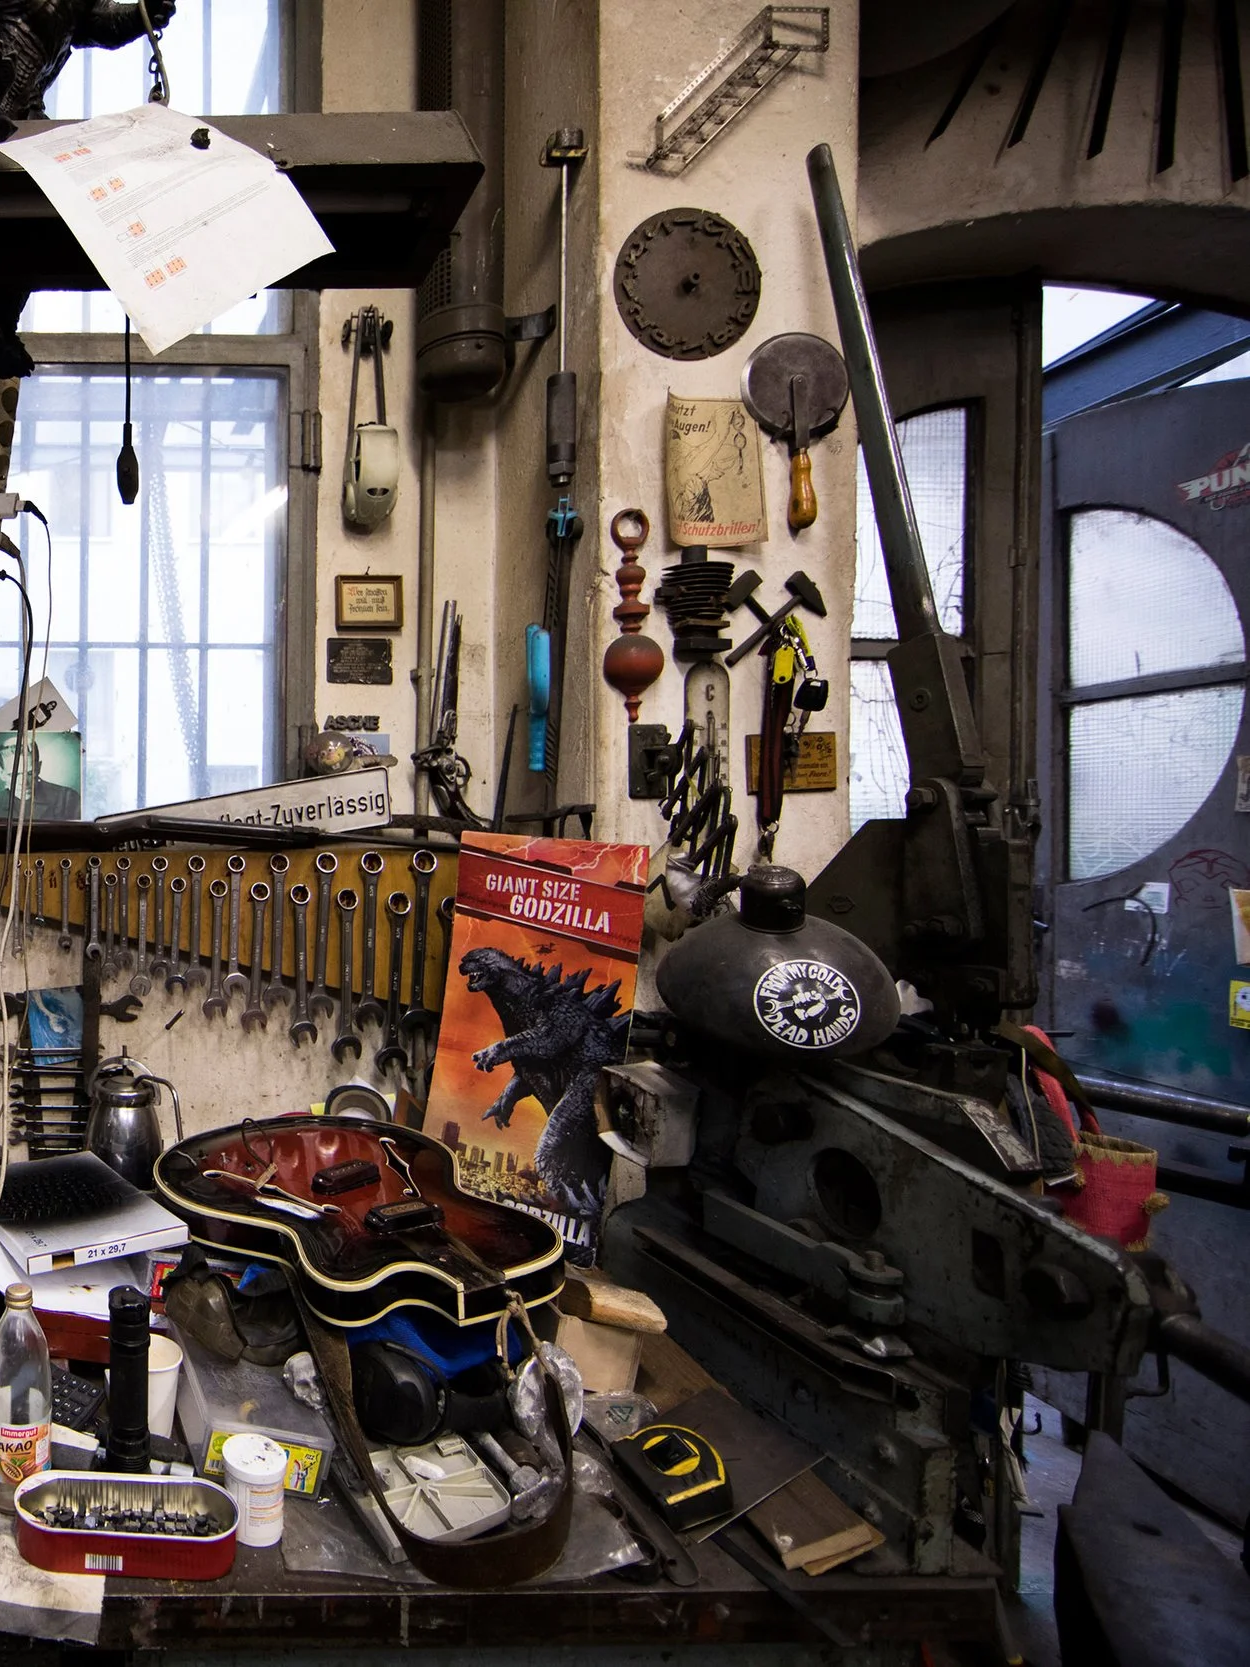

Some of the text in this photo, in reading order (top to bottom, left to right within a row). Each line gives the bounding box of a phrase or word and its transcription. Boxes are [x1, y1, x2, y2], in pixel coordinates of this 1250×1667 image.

[674, 419, 711, 436] Augen!
[682, 518, 761, 536] Schutzbrillen!
[323, 715, 382, 732] ASCHE
[485, 873, 581, 902] GIANT SIZE
[509, 894, 611, 934] GODZILLA
[759, 963, 844, 999] FROM MY COLD
[763, 1005, 856, 1046] DEAD HANDS
[87, 1243, 127, 1258] 21 x 29,7
[2, 1428, 38, 1438] Immergut
